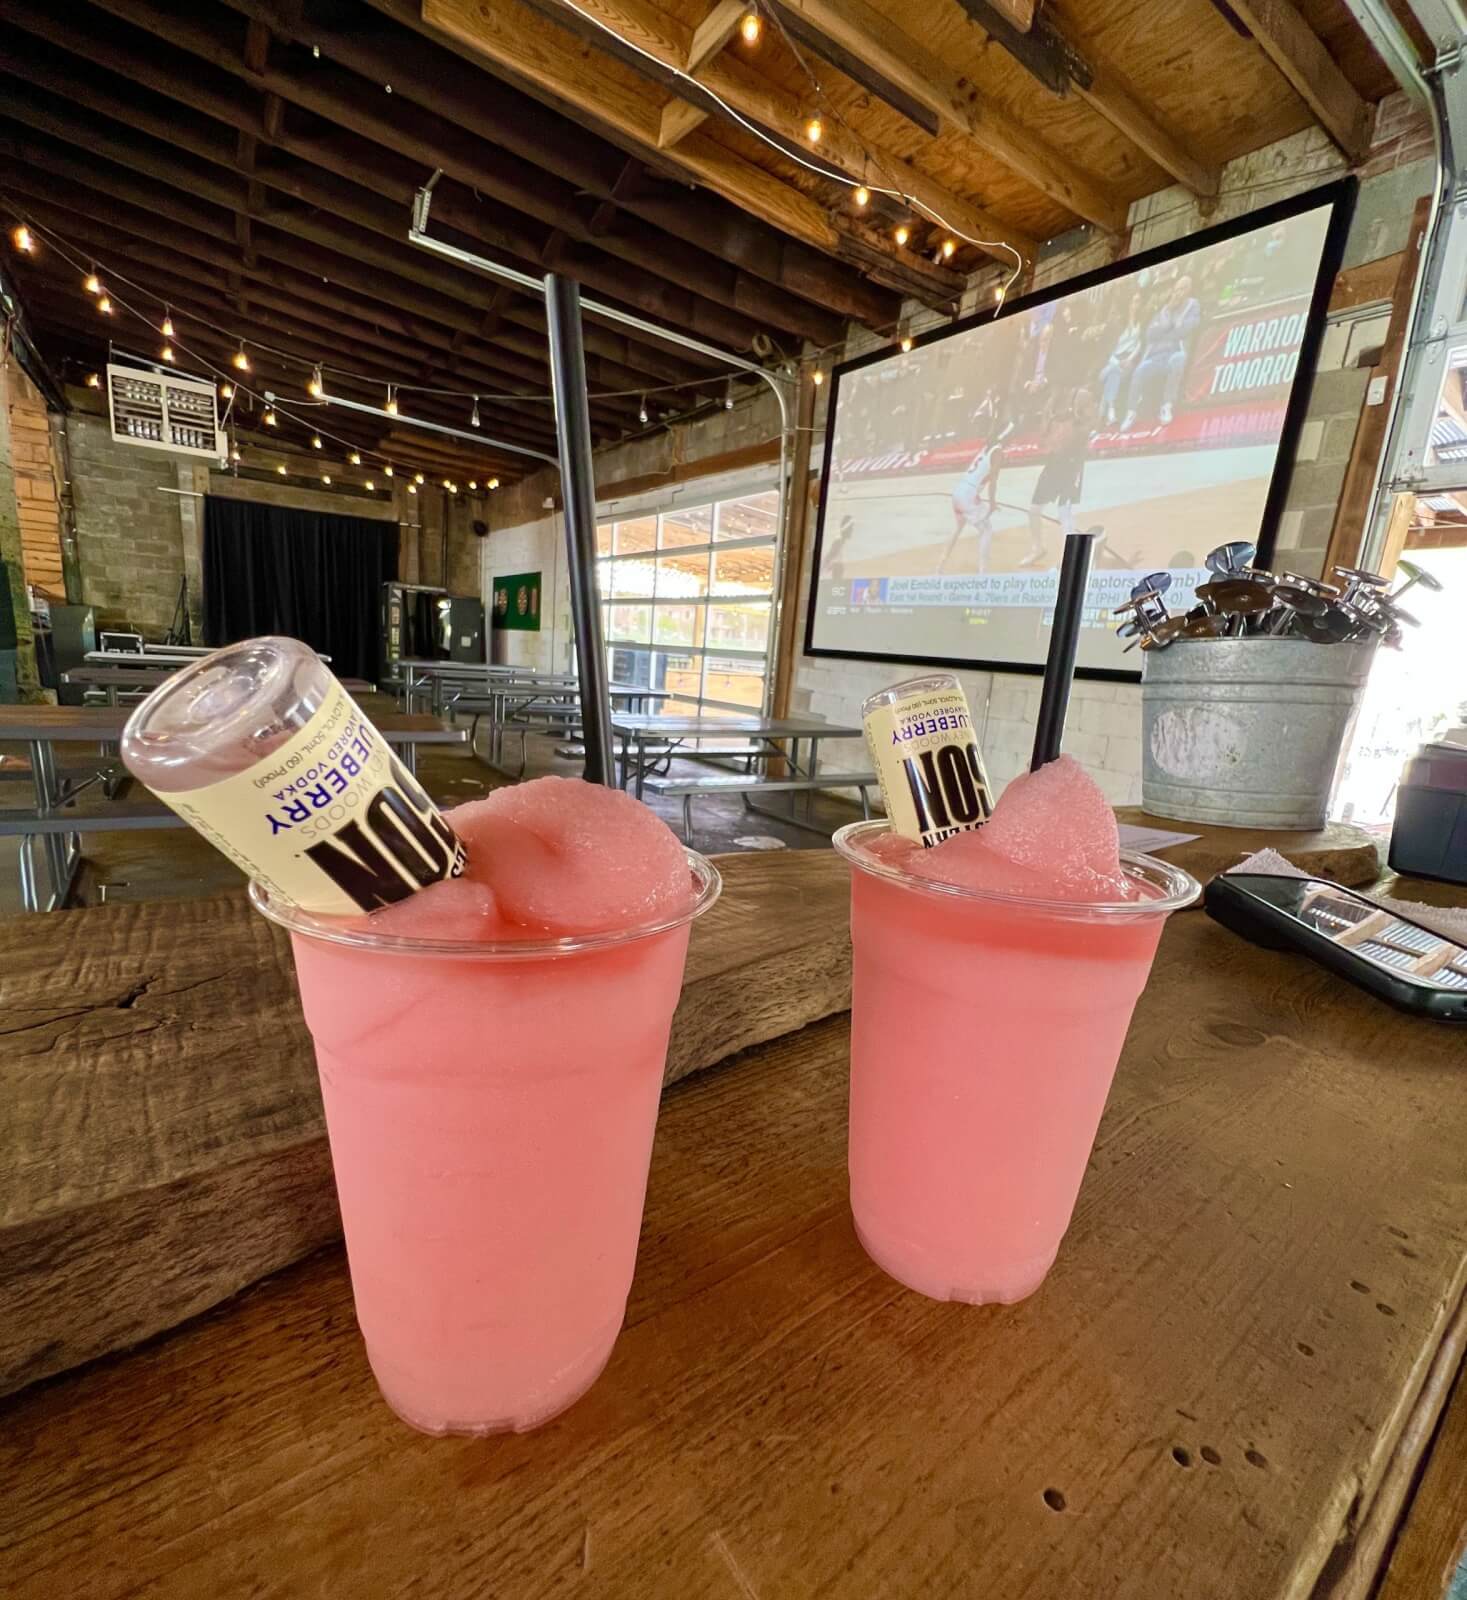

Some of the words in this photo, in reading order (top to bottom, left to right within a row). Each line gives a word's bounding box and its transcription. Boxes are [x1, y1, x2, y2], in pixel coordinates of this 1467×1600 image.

[943, 578, 988, 593] expected
[990, 578, 1001, 589] to
[1002, 577, 1026, 593] play
[1029, 577, 1056, 589] toda
[265, 724, 374, 835] UEBERRY
[286, 751, 304, 769] (60
[272, 762, 328, 801] VODKA
[301, 778, 373, 838] WOODS
